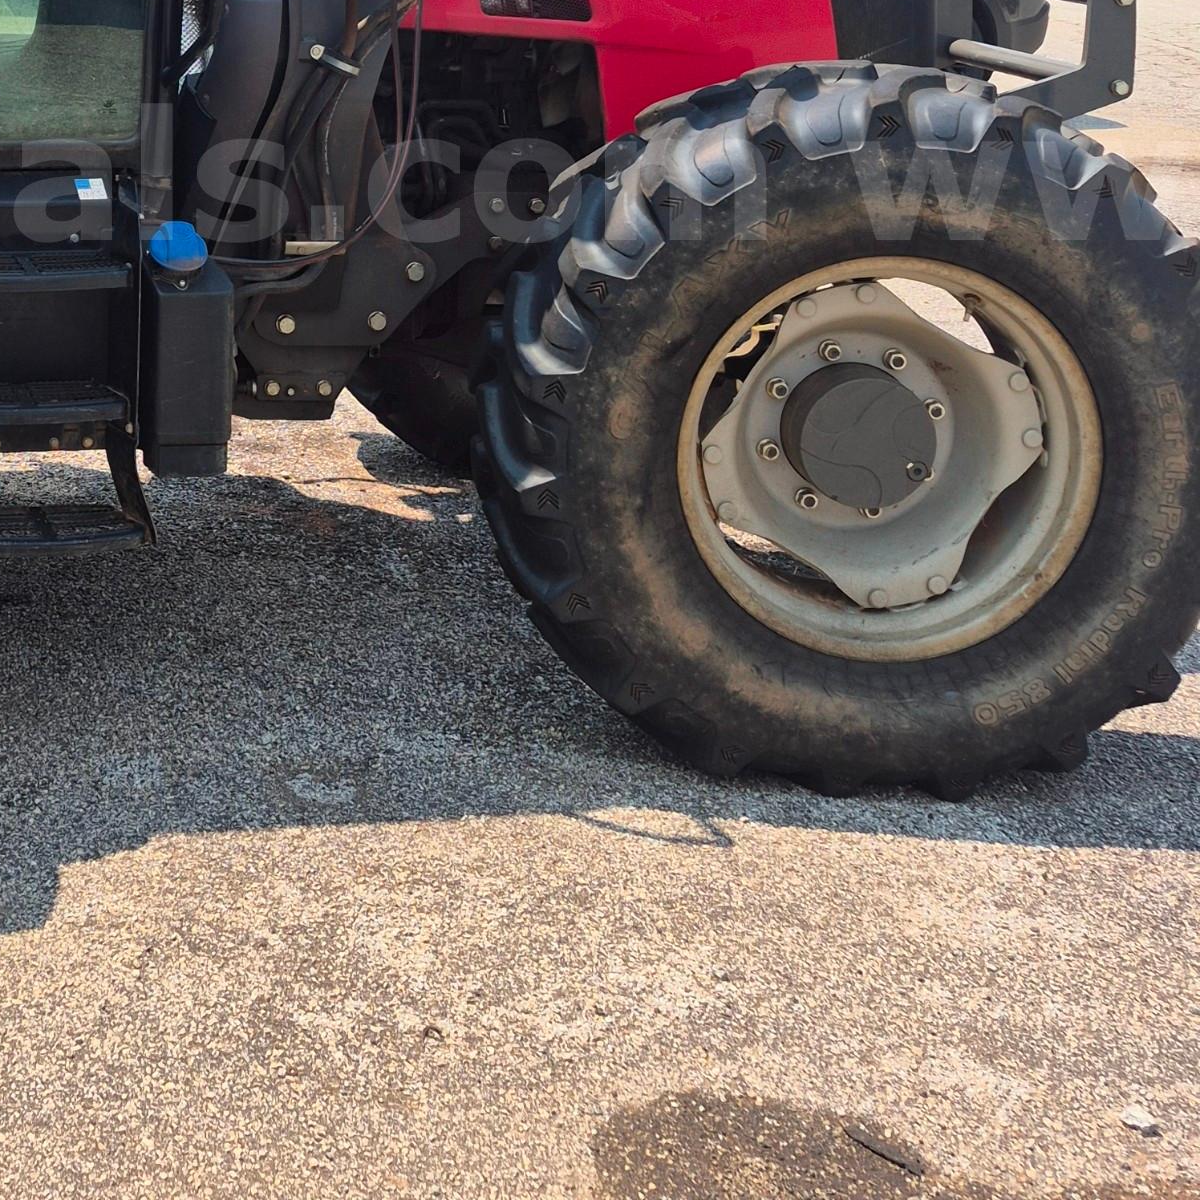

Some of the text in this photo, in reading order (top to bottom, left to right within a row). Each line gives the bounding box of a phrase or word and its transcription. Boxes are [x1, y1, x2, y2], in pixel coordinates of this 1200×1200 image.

[970, 381, 1185, 729] Earth-Pro Radial 850
